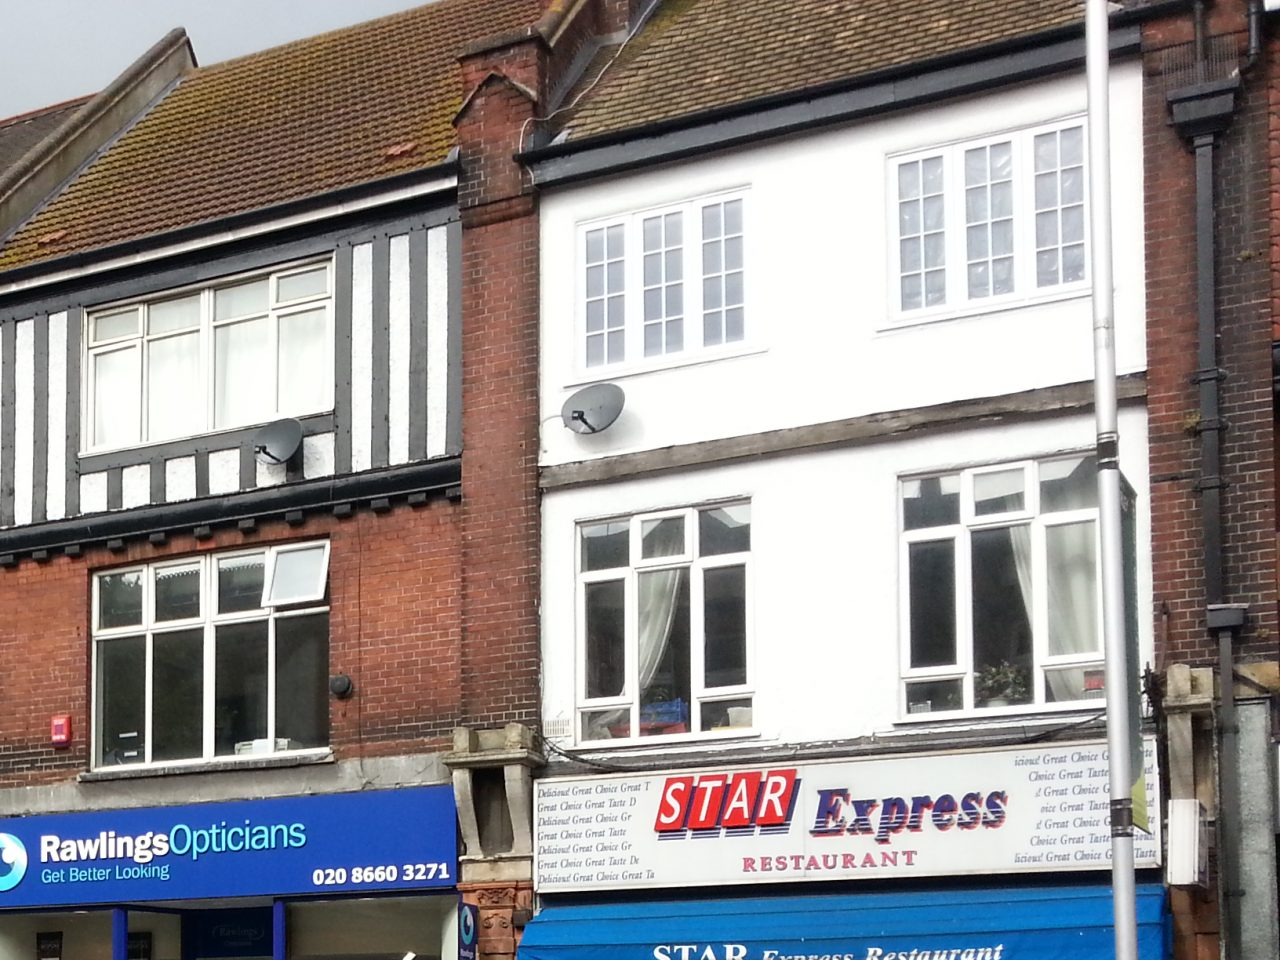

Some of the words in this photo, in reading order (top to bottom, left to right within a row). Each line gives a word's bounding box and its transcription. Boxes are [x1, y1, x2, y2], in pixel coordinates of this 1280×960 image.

[1043, 753, 1068, 765] Great
[1071, 751, 1098, 763] Choice
[1028, 770, 1056, 782] Choice
[1059, 768, 1083, 780] Great
[572, 786, 593, 796] Great
[595, 784, 618, 794] Choice
[620, 783, 641, 793] Great
[1043, 786, 1068, 797] Great
[1072, 784, 1099, 796] Choice
[537, 803, 557, 813] Great
[560, 801, 582, 811] Choice
[584, 800, 606, 809] Great
[608, 798, 626, 808] Taste
[660, 775, 788, 825] STAR
[809, 787, 1009, 845] Express
[1059, 802, 1084, 813] Great
[572, 815, 593, 825] Great
[595, 813, 618, 823] Choice
[1044, 819, 1069, 830] Great
[1073, 817, 1100, 828] Choice
[537, 832, 558, 841] Great
[560, 830, 583, 840] Choice
[585, 829, 606, 838] Great
[608, 827, 627, 837] Taste
[1030, 835, 1057, 847] Choice
[1060, 834, 1085, 845] Great
[572, 844, 593, 854] Great
[595, 842, 619, 852] Choice
[537, 860, 558, 870] Great
[560, 858, 583, 868] Choice
[585, 857, 606, 867] Great
[609, 856, 627, 866] Taste
[742, 850, 918, 873] RESTAURANT
[1046, 851, 1071, 863] Great
[1074, 849, 1102, 861] Choice
[41, 868, 66, 884] Get
[70, 865, 112, 882] Better
[115, 863, 170, 881] Looking
[312, 868, 347, 886] 020
[351, 865, 398, 884] 8660
[402, 863, 450, 881] 3271
[573, 873, 594, 883] Great
[596, 871, 619, 881] Choice
[621, 870, 643, 880] Great
